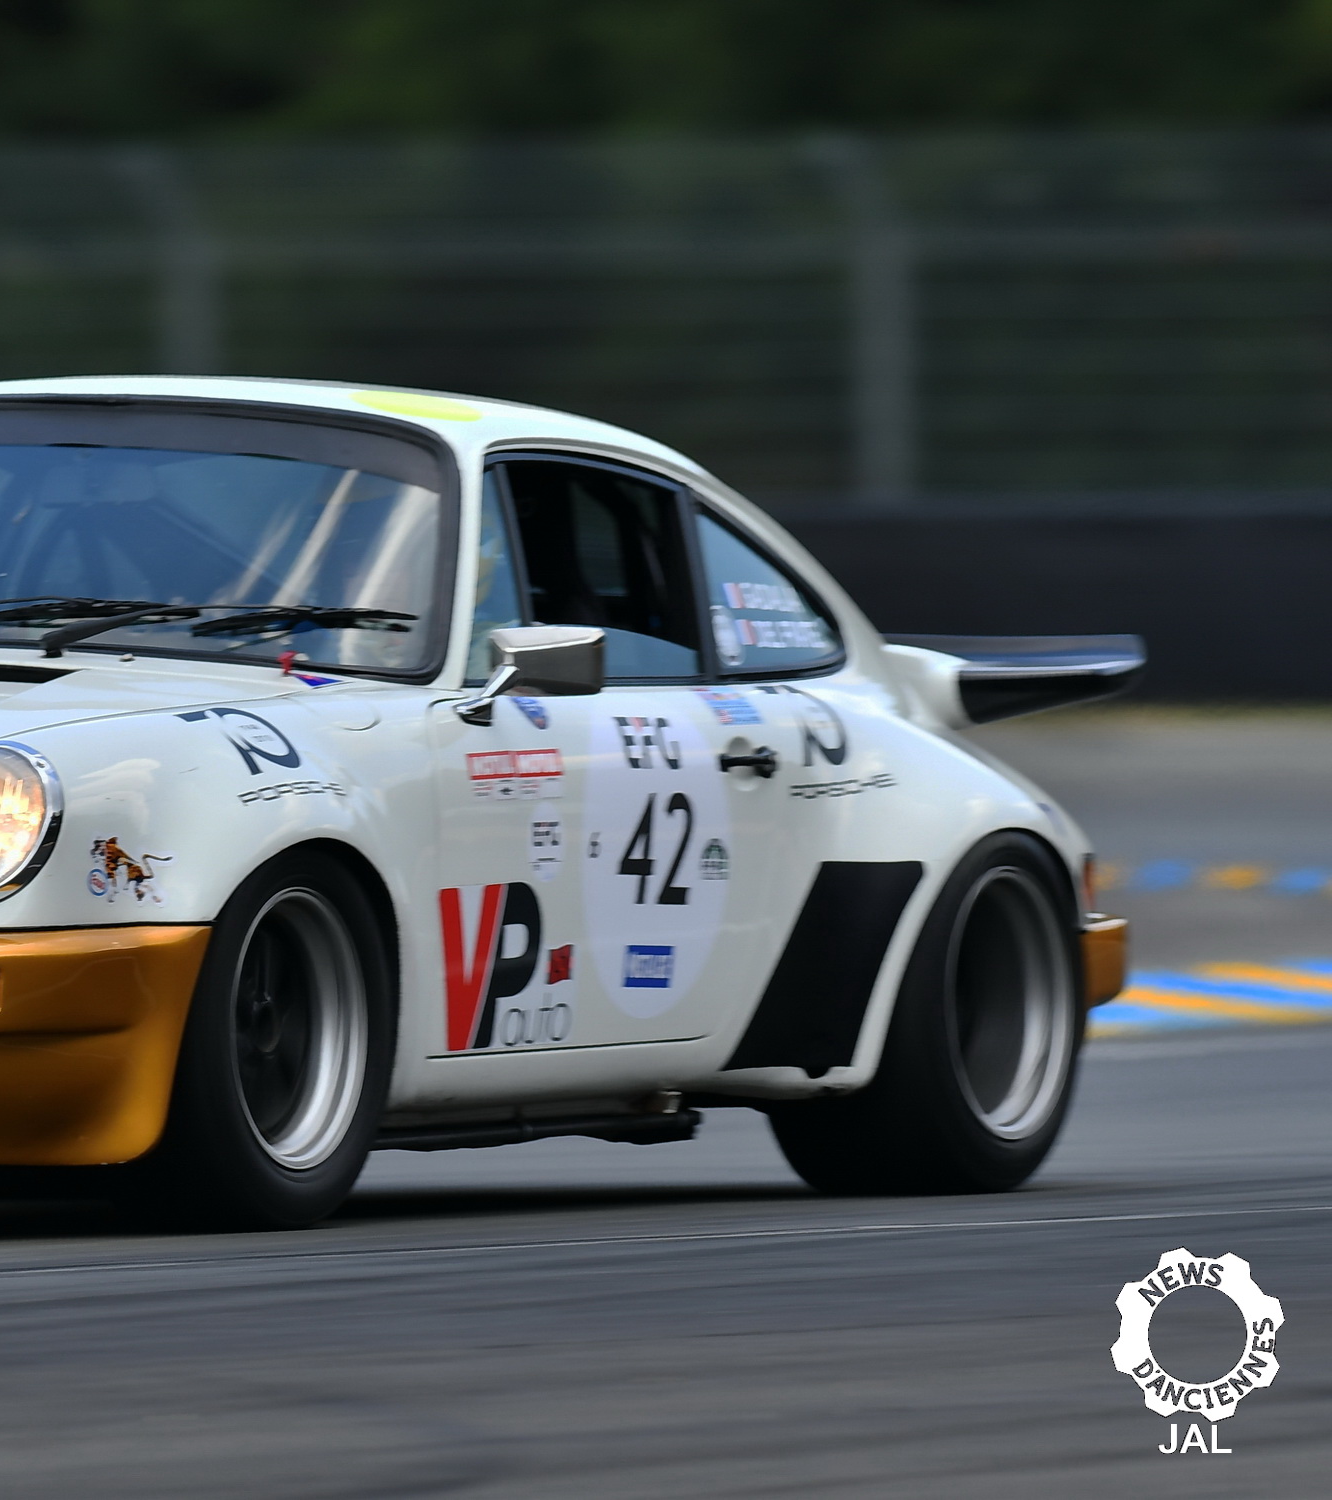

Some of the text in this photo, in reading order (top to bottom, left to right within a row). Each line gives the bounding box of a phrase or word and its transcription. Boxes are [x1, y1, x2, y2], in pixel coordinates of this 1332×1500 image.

[613, 716, 680, 769] EFG
[617, 792, 693, 905] 42
[439, 881, 542, 1051] VP
